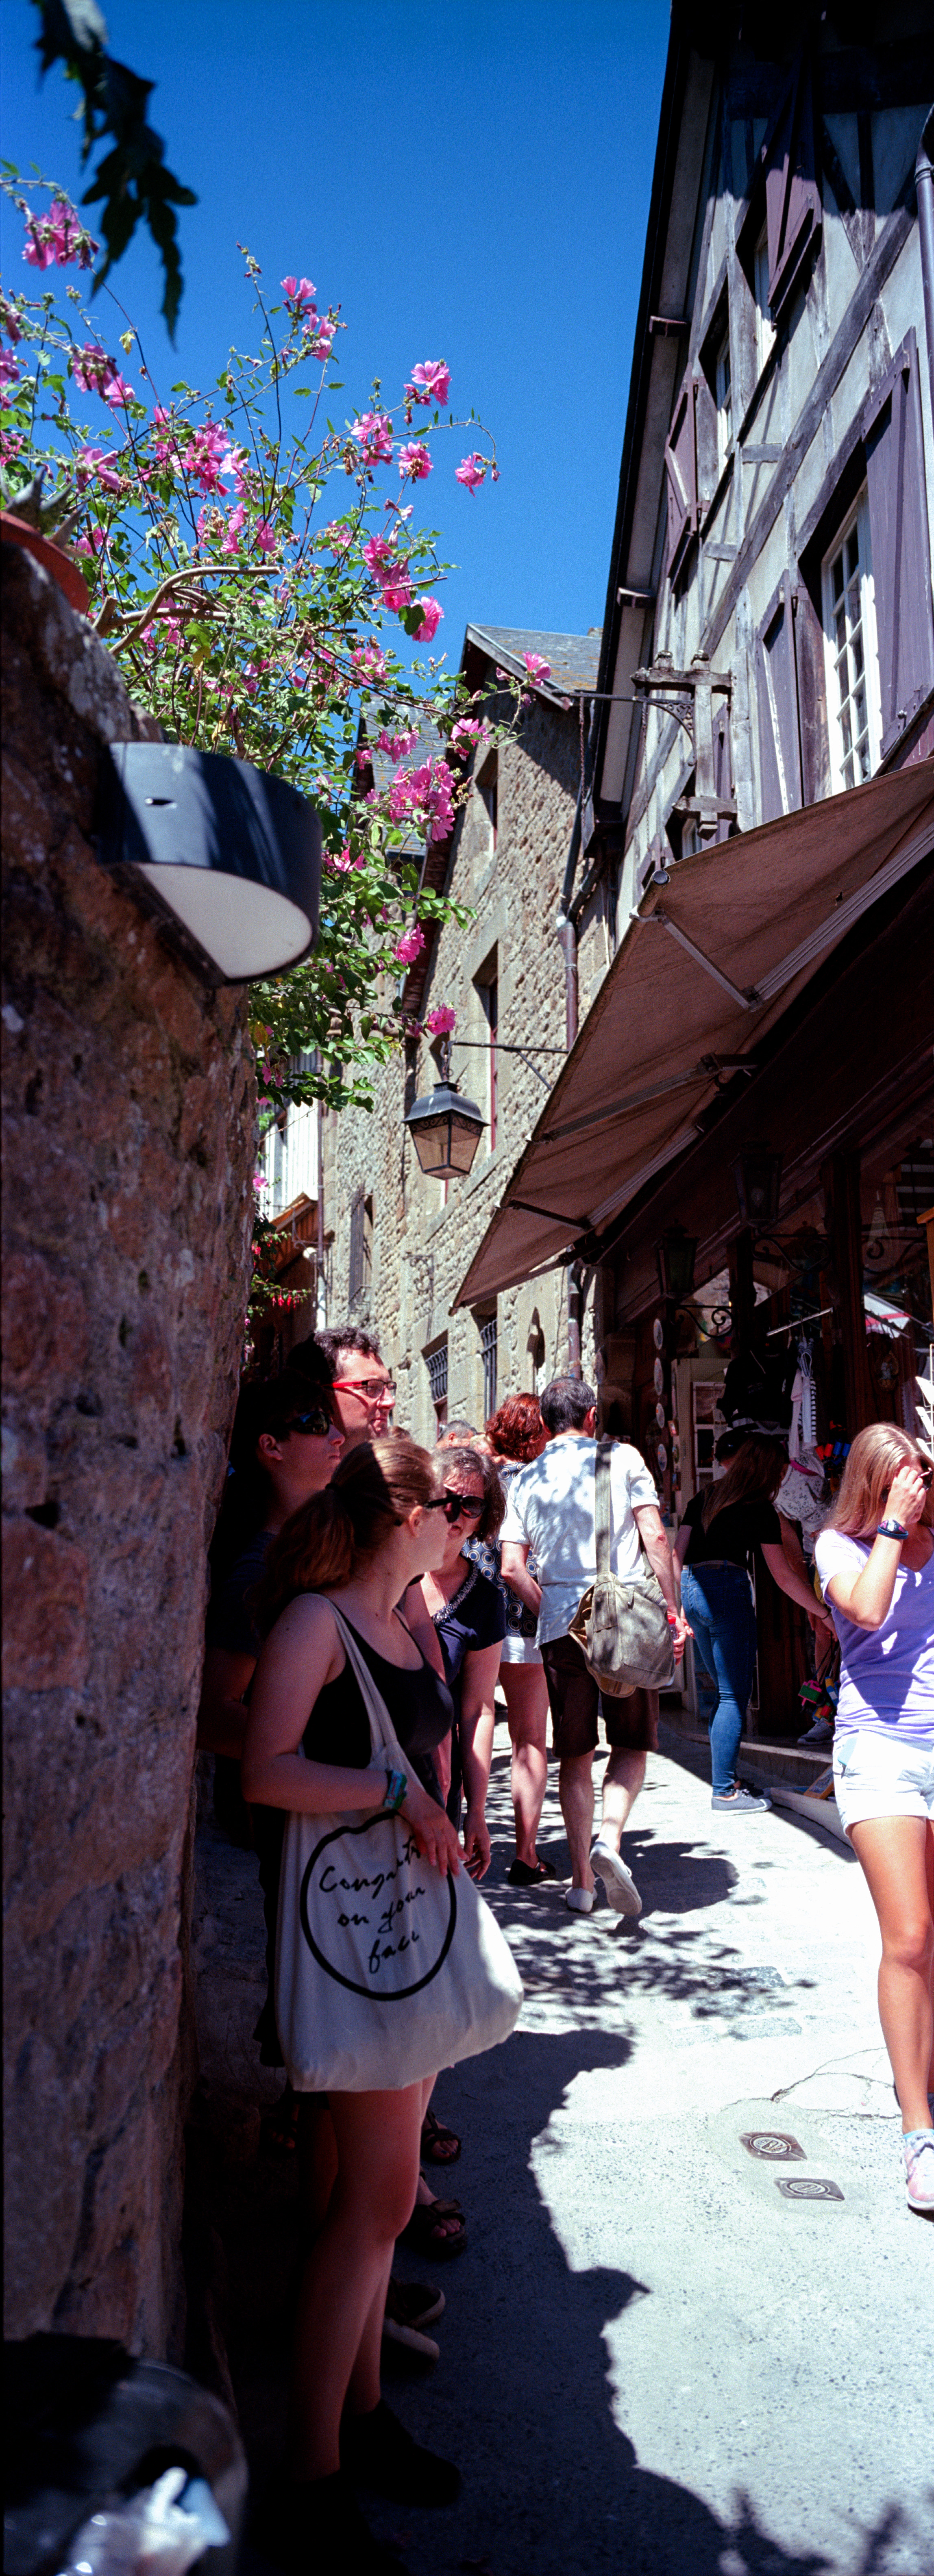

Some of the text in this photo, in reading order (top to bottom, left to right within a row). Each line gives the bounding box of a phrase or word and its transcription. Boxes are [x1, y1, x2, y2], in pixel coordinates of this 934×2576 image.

[337, 1887, 425, 1934] on your
[368, 1931, 420, 1974] face
